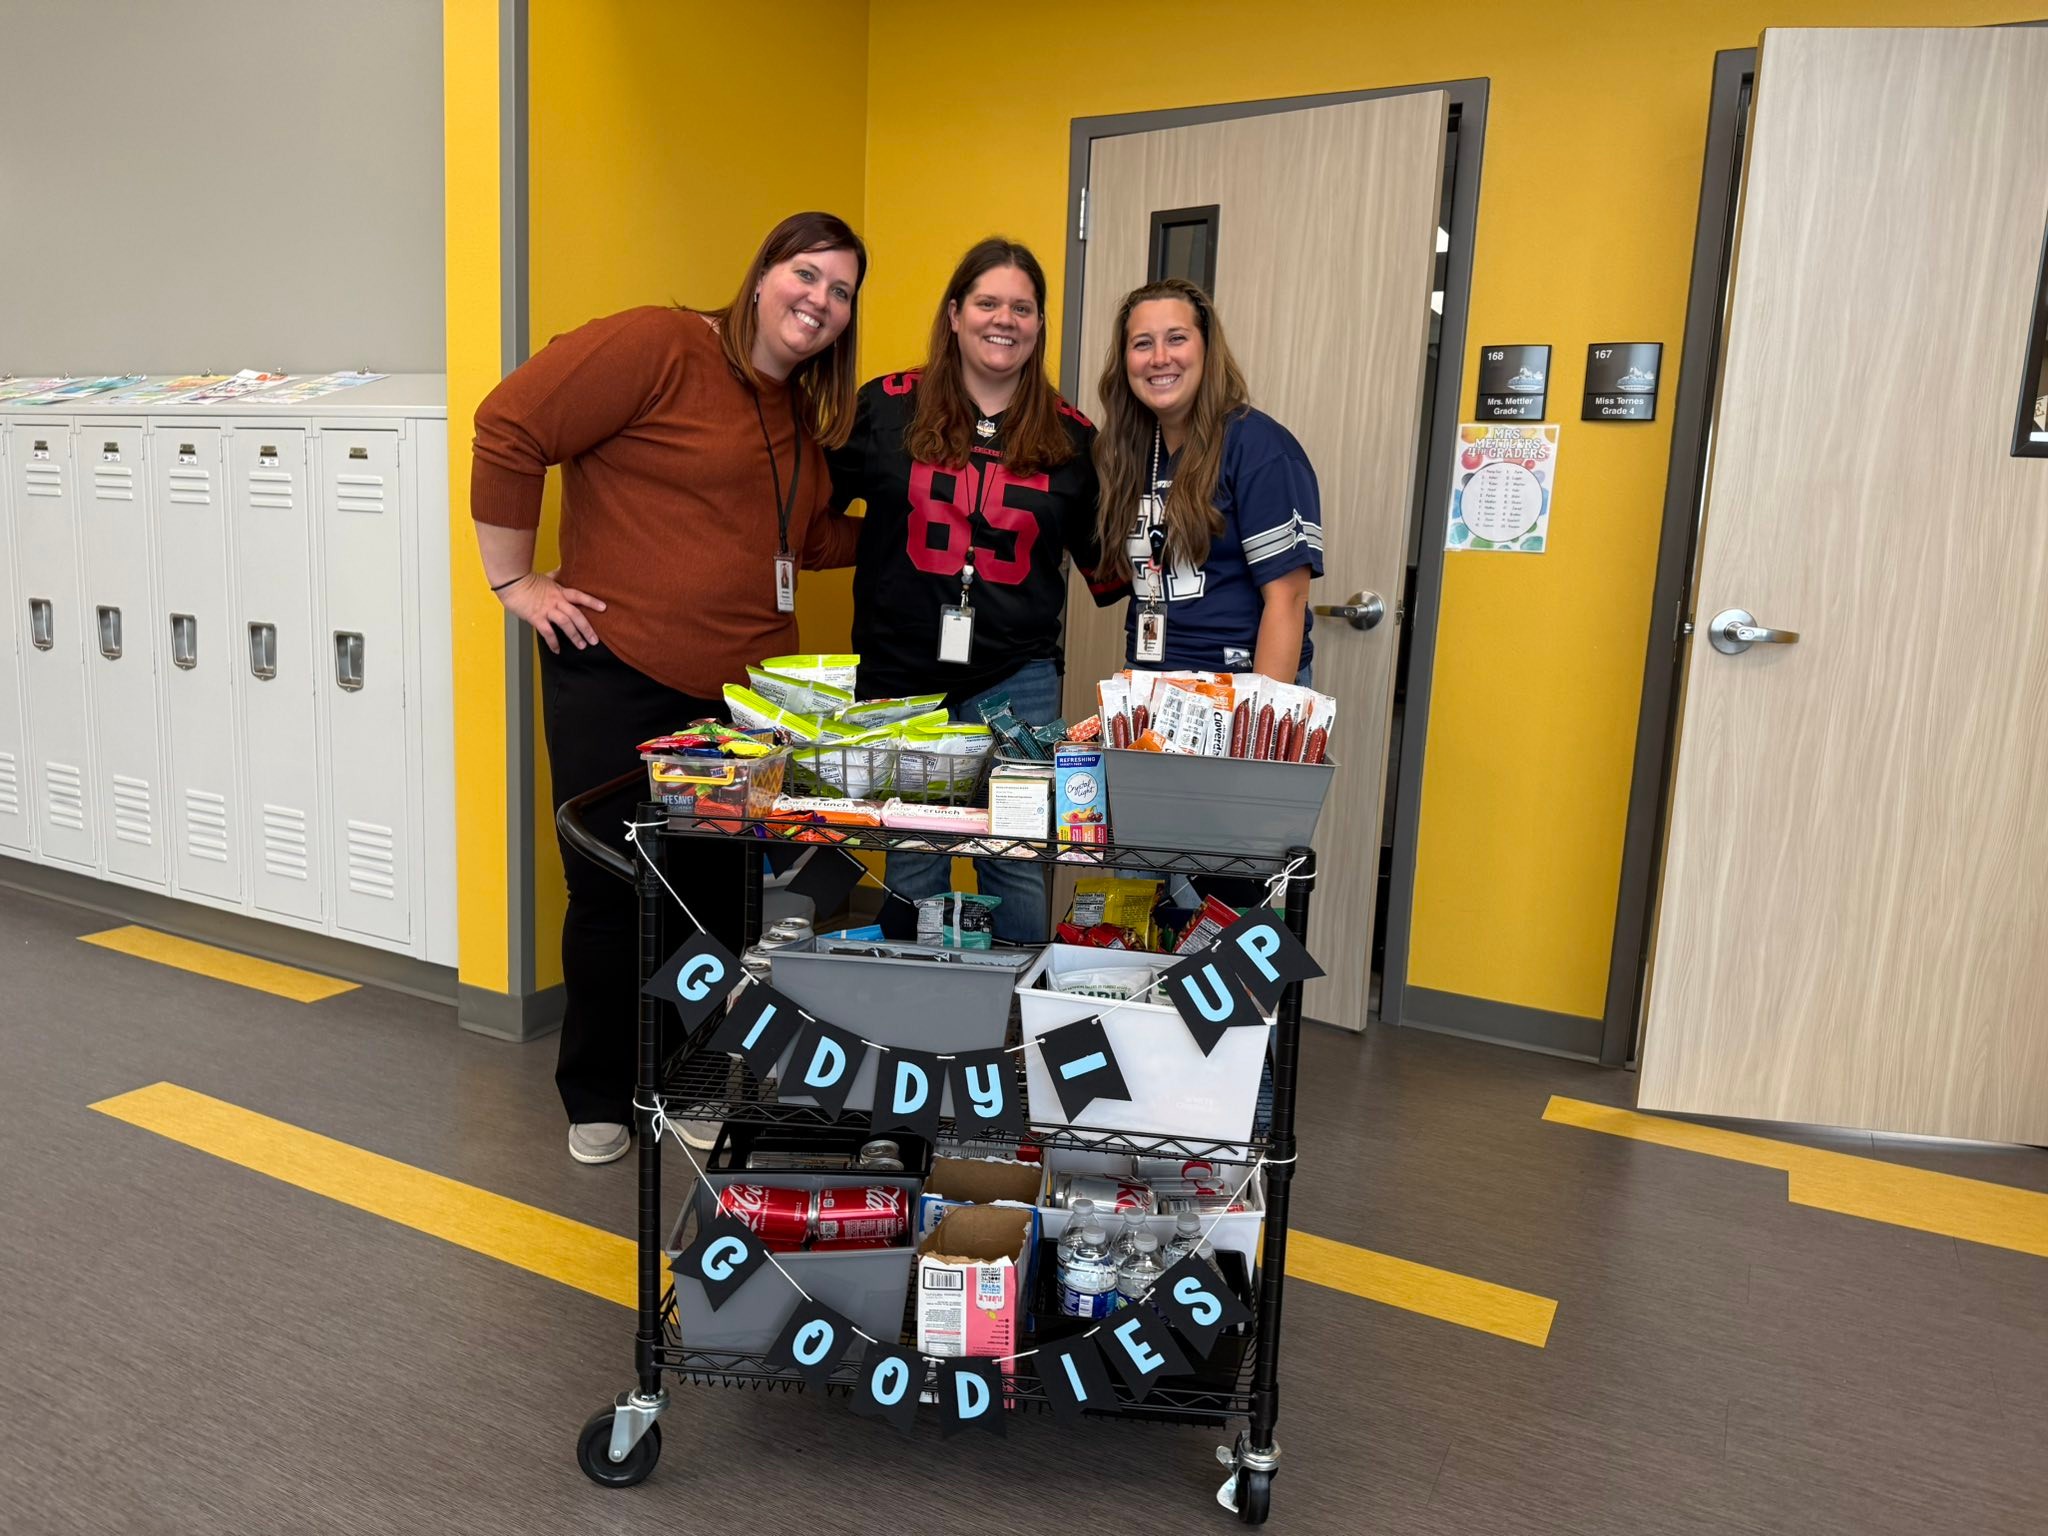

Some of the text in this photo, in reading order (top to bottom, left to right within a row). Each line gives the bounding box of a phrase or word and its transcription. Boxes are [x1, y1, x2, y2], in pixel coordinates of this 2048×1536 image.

[1487, 351, 1504, 361] 168
[1595, 349, 1612, 359] 167
[1487, 397, 1533, 406] Mrs. Mettler
[1595, 397, 1614, 405] Miss
[1493, 407, 1525, 415] Grade 4
[1602, 407, 1635, 415] Grade 4
[1488, 448, 1547, 459] GRADERS
[906, 461, 1049, 585] 85
[1067, 780, 1091, 794] Crystal
[923, 808, 961, 816] crunch
